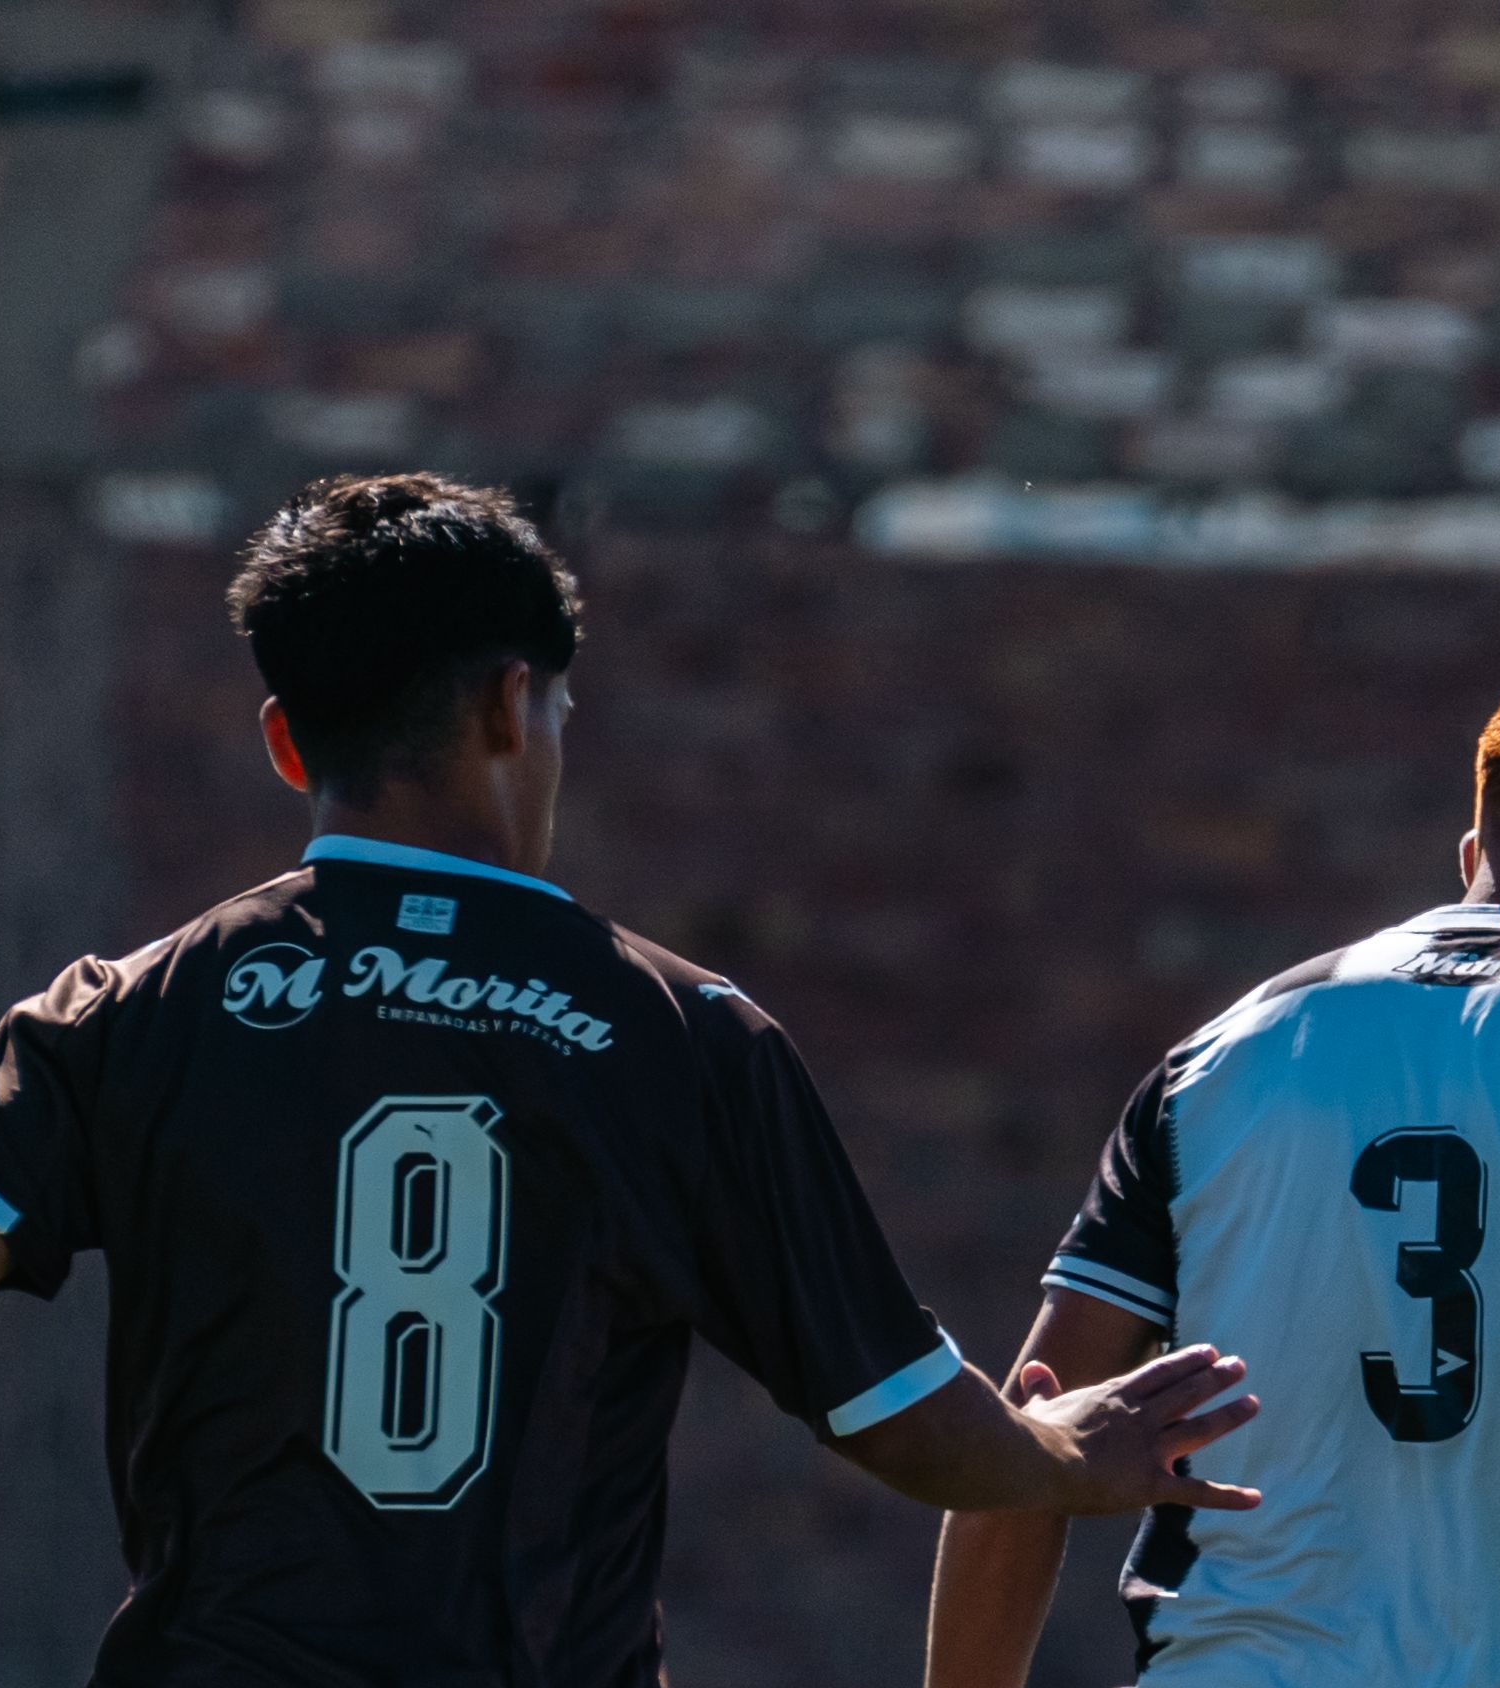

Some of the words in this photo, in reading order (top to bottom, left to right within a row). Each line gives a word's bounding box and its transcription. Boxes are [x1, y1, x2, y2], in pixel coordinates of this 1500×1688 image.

[222, 957, 328, 1014] M
[342, 945, 614, 1053] Morita
[492, 1018, 503, 1032] Y
[321, 1095, 510, 1512] 8
[1350, 1124, 1489, 1443] 3
